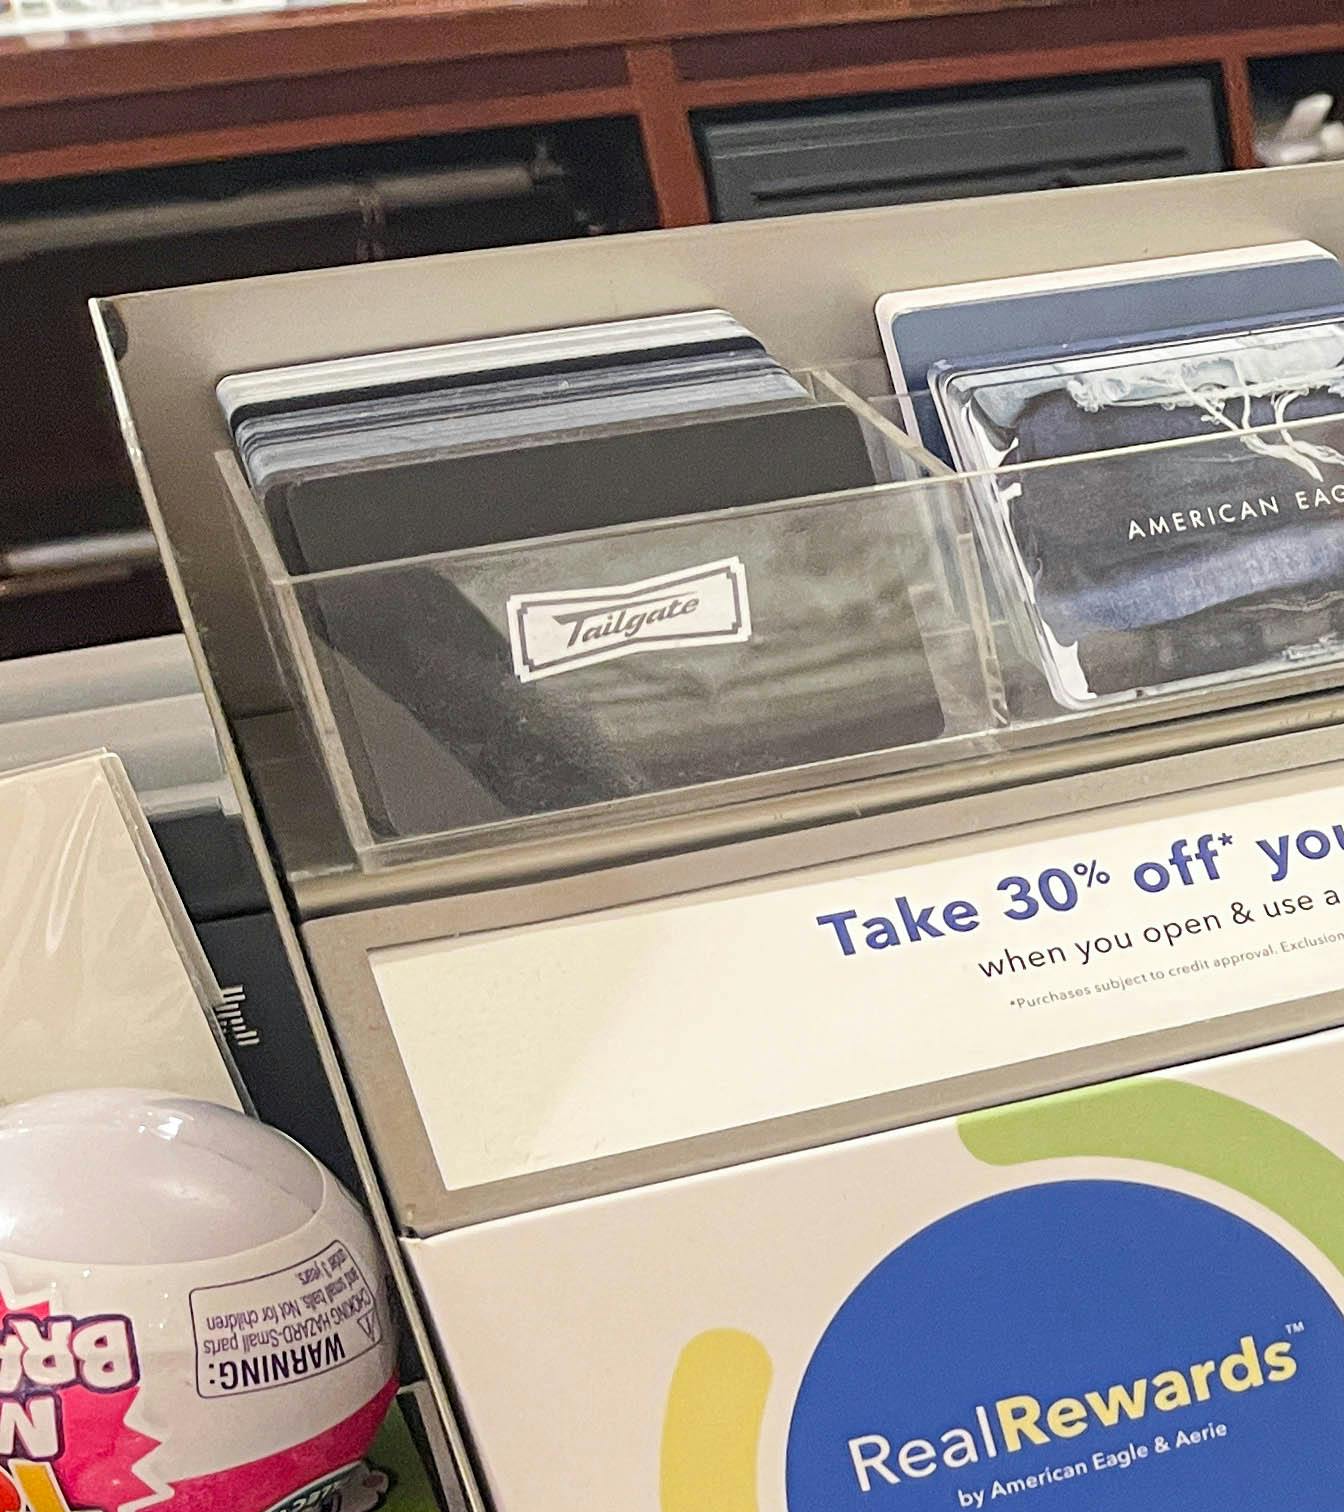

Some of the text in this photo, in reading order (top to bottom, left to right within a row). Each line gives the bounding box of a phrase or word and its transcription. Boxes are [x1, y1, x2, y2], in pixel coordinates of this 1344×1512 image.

[1127, 495, 1280, 541] AMERICAN
[552, 591, 700, 648] Tailgate
[814, 895, 980, 957] Take
[995, 858, 1111, 921] 30%
[976, 945, 1067, 978] when
[1073, 931, 1133, 966] you
[1142, 913, 1222, 947] open
[1229, 900, 1255, 925] &
[1261, 894, 1314, 918] use
[1322, 888, 1341, 906] a
[1093, 972, 1148, 993] subject
[1148, 969, 1165, 981] to
[1167, 958, 1210, 977] credit
[203, 1331, 239, 1355] parts
[205, 1299, 302, 1331] Not for children
[208, 1333, 346, 1390] WARNING:
[956, 1421, 1227, 1509] by American Eagle & Aerie
